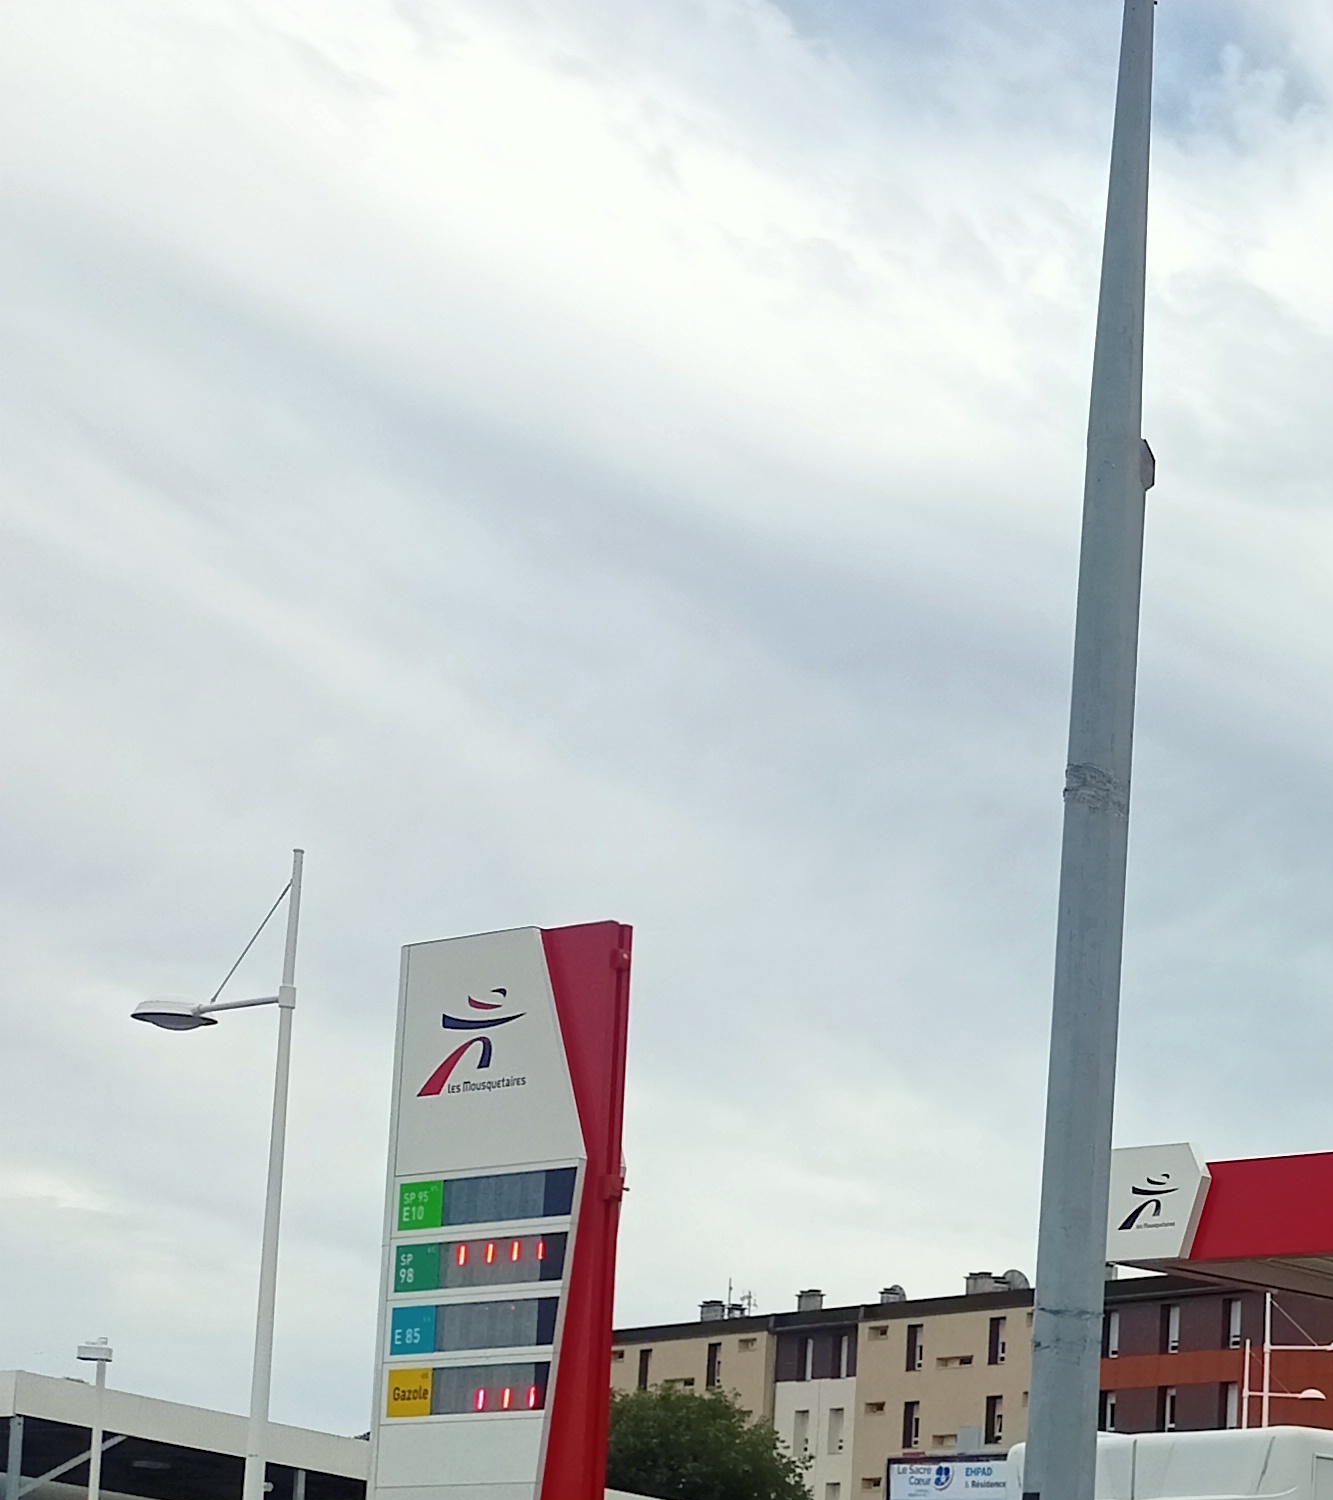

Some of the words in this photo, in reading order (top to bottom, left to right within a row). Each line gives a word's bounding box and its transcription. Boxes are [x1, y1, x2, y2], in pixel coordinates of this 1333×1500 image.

[463, 1076, 527, 1092] Mousquetaires
[403, 1192, 416, 1205] SP
[417, 1190, 429, 1203] 95
[402, 1206, 425, 1222] E10
[400, 1253, 414, 1266] SP
[399, 1268, 414, 1283] 98
[405, 1327, 421, 1344] 85
[392, 1385, 429, 1401] Gazole
[965, 1466, 993, 1477] EHPAD
